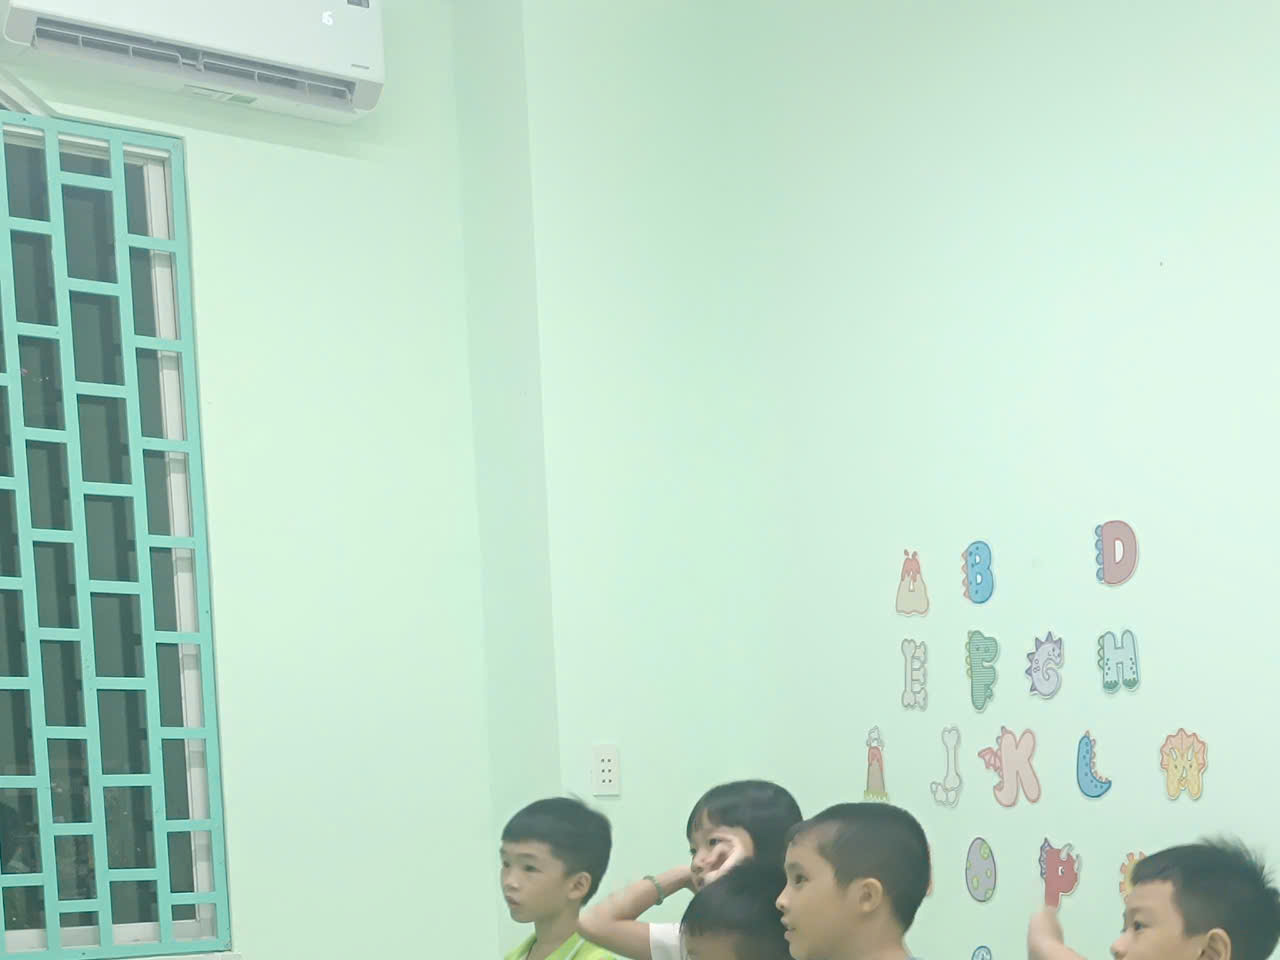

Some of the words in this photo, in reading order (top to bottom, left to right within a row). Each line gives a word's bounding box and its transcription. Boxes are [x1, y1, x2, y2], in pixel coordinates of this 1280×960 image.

[961, 541, 994, 604] B
[1095, 520, 1138, 585] D
[901, 638, 928, 710] E
[1098, 629, 1140, 692] H
[978, 726, 1041, 807] K
[1077, 730, 1112, 798] L
[1039, 838, 1081, 910] P
